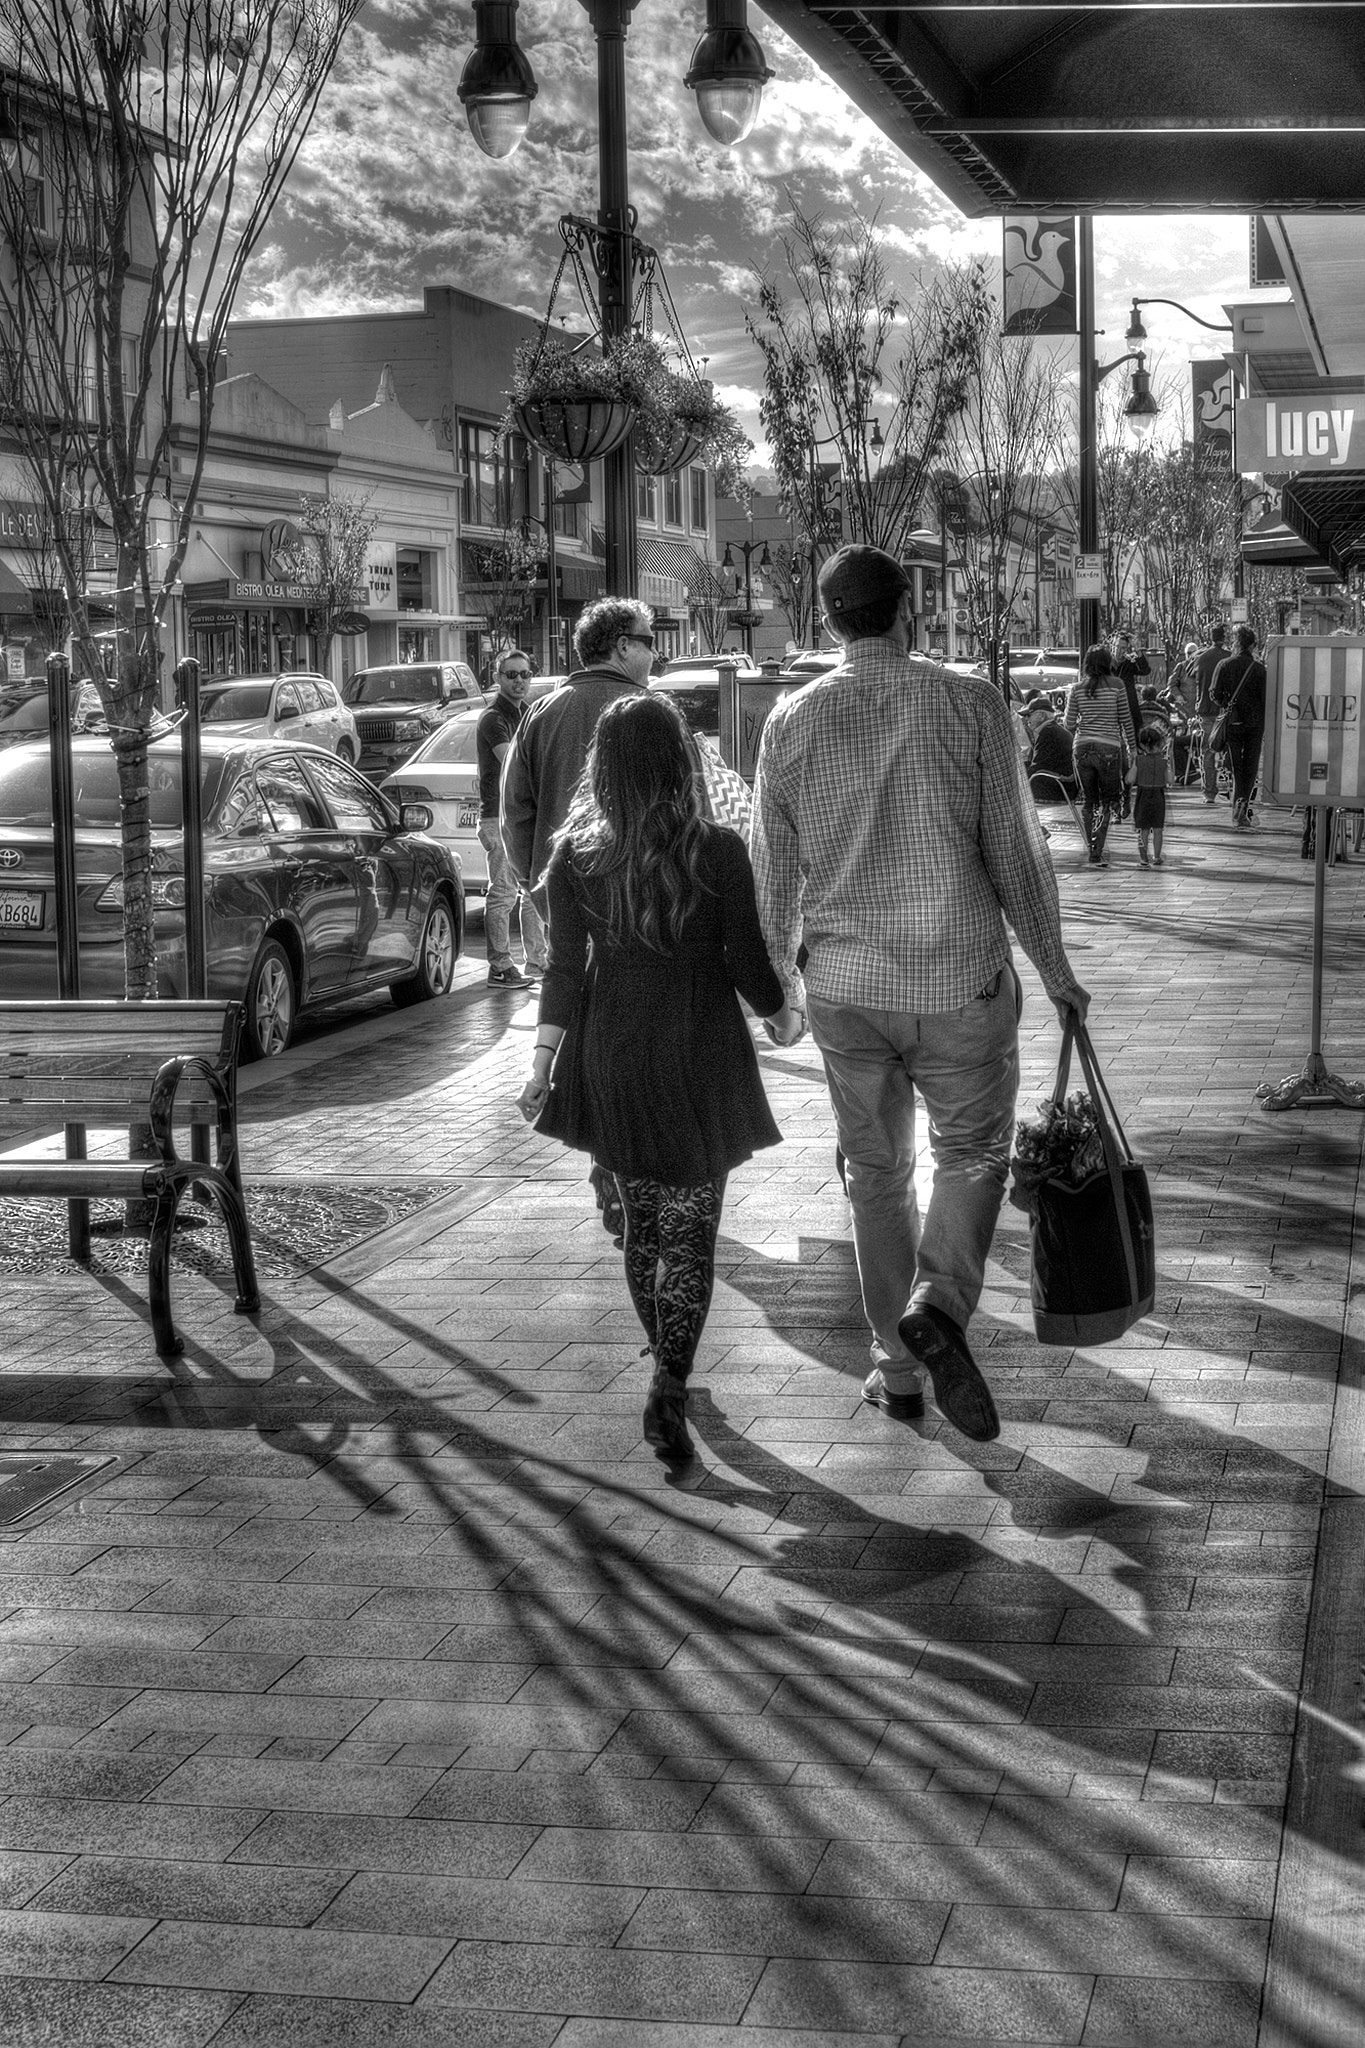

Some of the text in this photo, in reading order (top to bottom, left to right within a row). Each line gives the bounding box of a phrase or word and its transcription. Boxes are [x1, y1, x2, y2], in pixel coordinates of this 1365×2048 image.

[1266, 402, 1355, 466] lucy
[1076, 557, 1085, 568] 2
[369, 565, 394, 576] TRINA
[236, 583, 262, 597] BISTRO
[265, 585, 285, 598] OLEA
[369, 581, 391, 591] TURK
[1286, 693, 1358, 722] SALE
